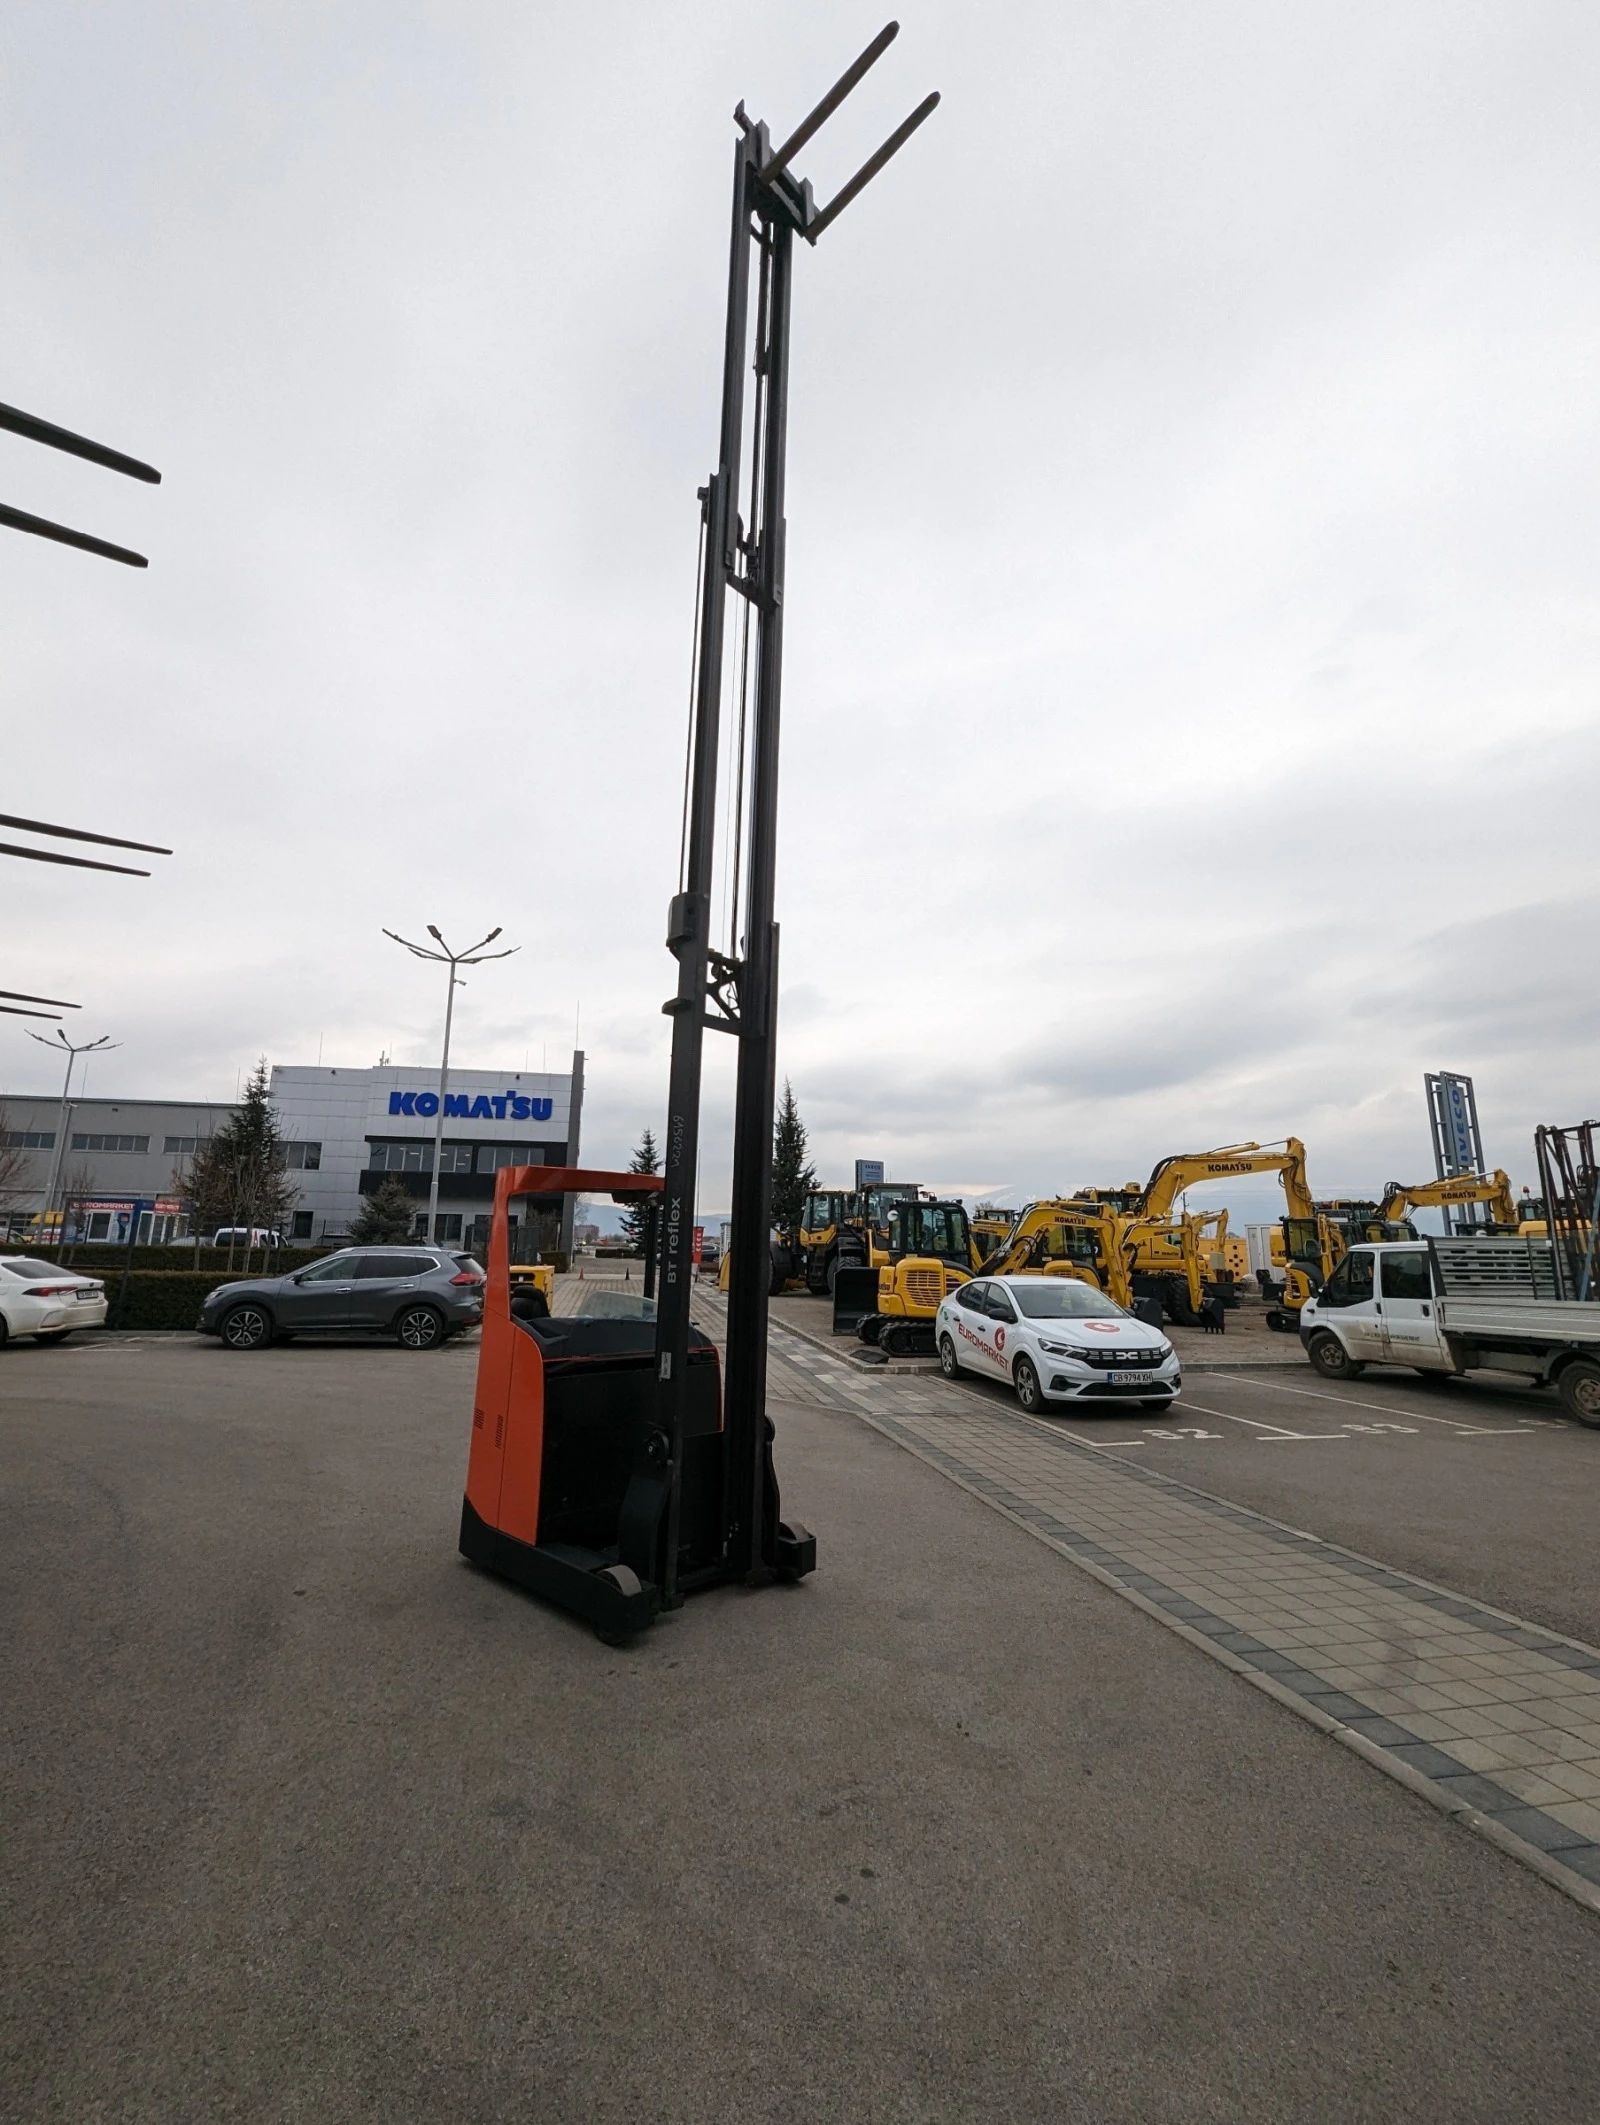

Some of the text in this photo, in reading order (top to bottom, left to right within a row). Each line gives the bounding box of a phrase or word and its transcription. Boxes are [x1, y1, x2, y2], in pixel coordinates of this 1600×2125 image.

[388, 1089, 553, 1121] KOMATSU
[1452, 1089, 1468, 1162] IVECO
[671, 1115, 684, 1168] 6156221
[1207, 1161, 1253, 1173] KOMATSU
[1441, 1190, 1477, 1200] KOMATSU
[1055, 1216, 1087, 1225] KOMATSU
[667, 1197, 681, 1283] BT reflex
[958, 1323, 1009, 1371] EUROMARKET
[1123, 1373, 1141, 1382] 9794
[1142, 1428, 1224, 1440] 82
